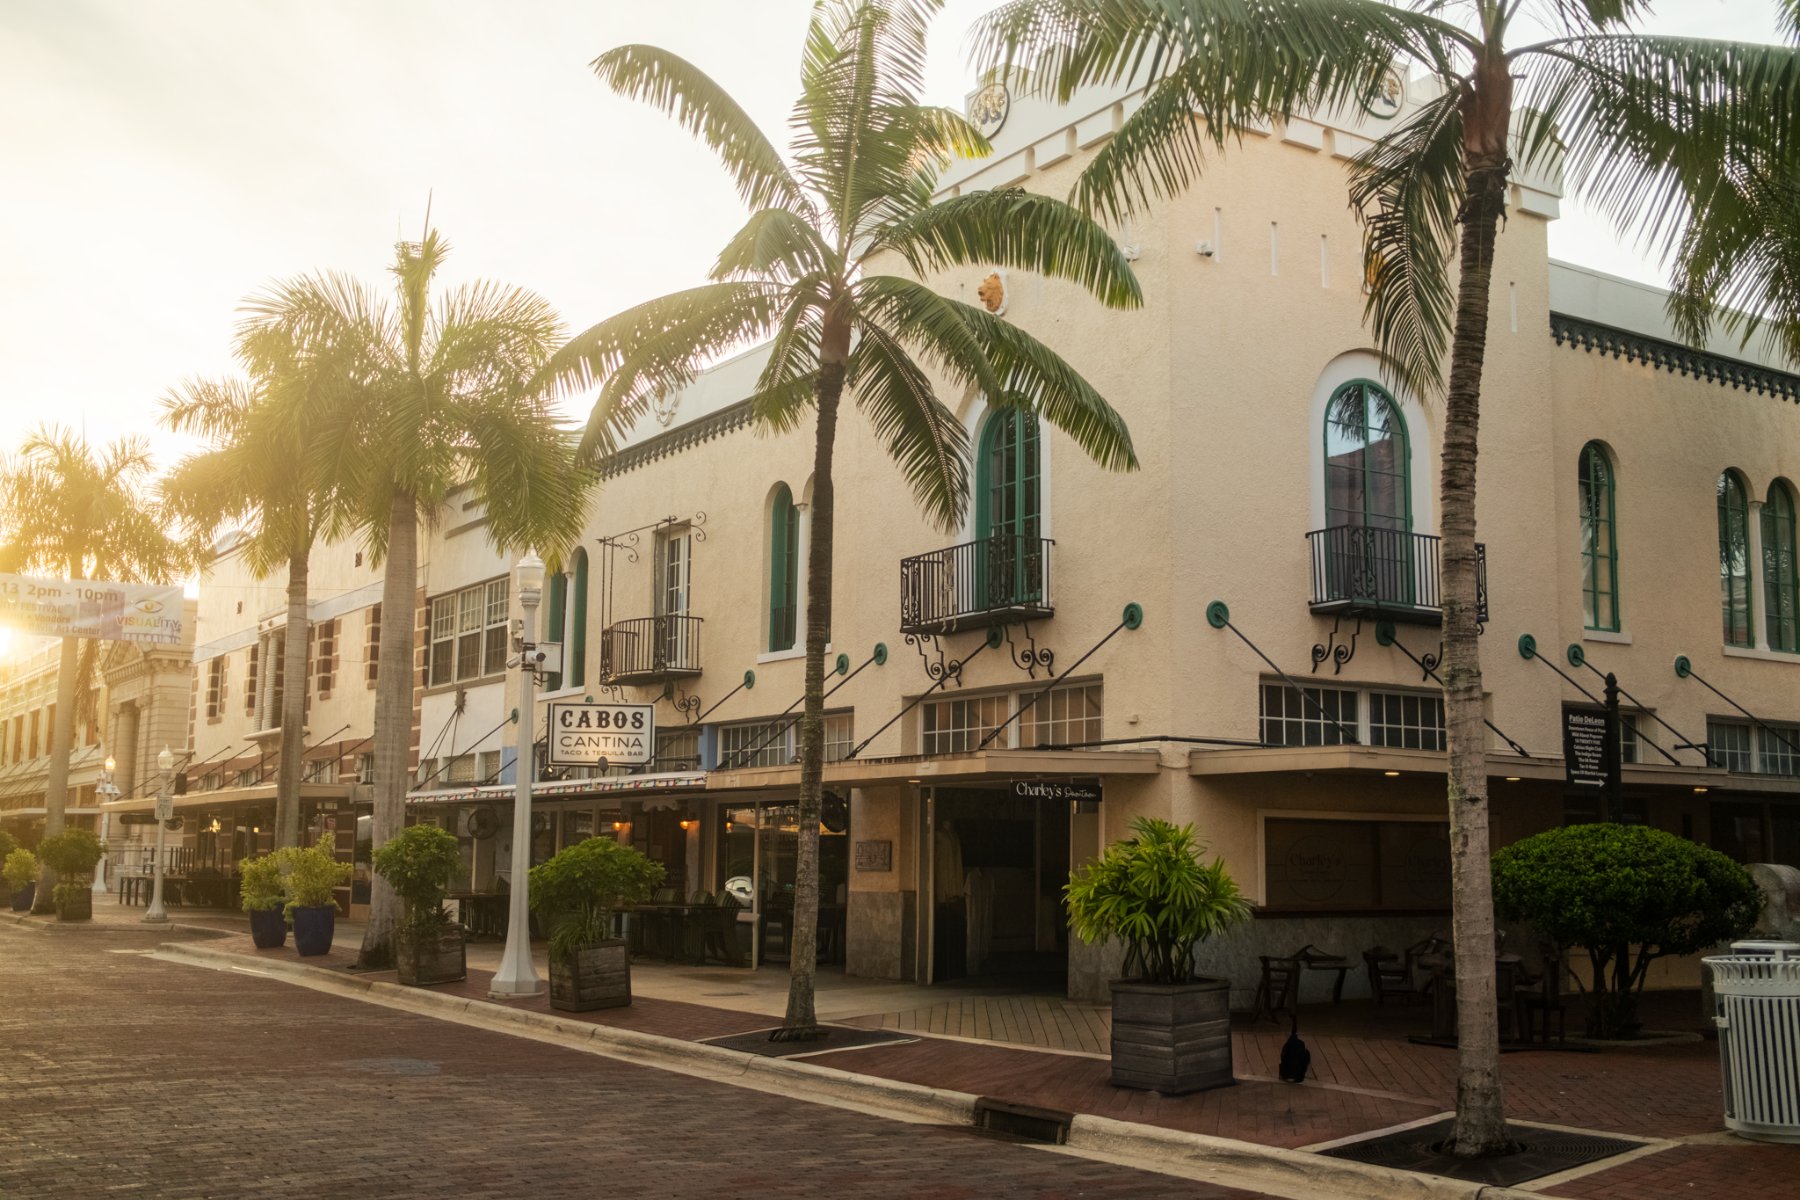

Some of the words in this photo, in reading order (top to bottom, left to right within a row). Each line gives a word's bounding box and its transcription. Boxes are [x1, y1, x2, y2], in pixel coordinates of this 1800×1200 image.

[27, 584, 62, 599] 2pm
[76, 588, 118, 602] 10pm
[116, 615, 180, 630] VISUALITY
[72, 626, 101, 635] Center
[560, 710, 644, 729] CABOS
[1568, 714, 1584, 723] Patio
[1584, 716, 1605, 726] DeLeon
[560, 736, 644, 748] CANTINA
[1016, 782, 1062, 799] Charley's
